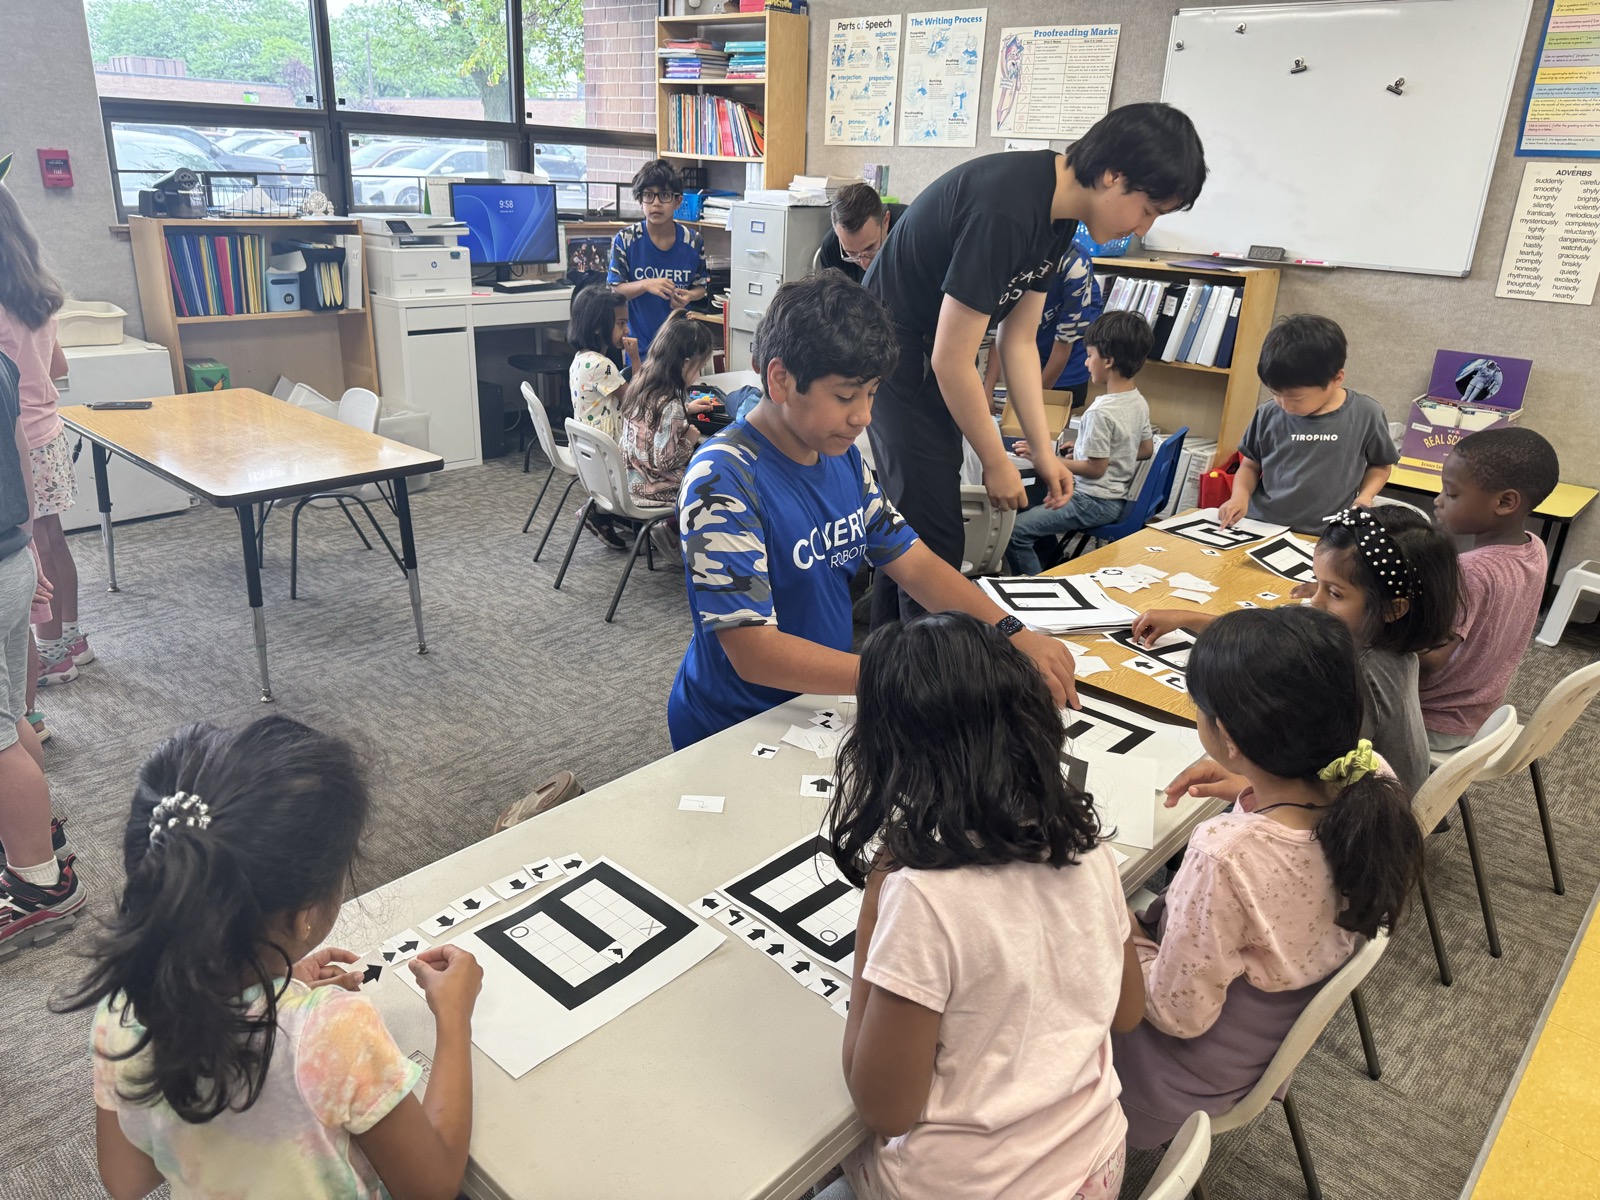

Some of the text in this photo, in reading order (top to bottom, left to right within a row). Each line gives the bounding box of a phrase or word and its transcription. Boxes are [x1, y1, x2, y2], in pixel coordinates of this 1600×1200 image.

[838, 18, 892, 31] Parts of Speech
[910, 16, 982, 27] The Writing Process
[1034, 28, 1118, 38] Proofreading Marks
[499, 200, 514, 208] 9:58
[1527, 210, 1556, 218] frantically
[1520, 218, 1559, 226] mysteriously
[1565, 221, 1600, 229] completely
[1559, 236, 1598, 245] dangerously
[1558, 253, 1590, 261] graciously
[634, 266, 691, 282] COVERT
[1507, 273, 1543, 281] rhythmically
[1506, 280, 1541, 289] thoughtfully
[1554, 277, 1581, 285] excitedly
[1423, 434, 1445, 448] REAL
[830, 544, 868, 568] ROBOTI
